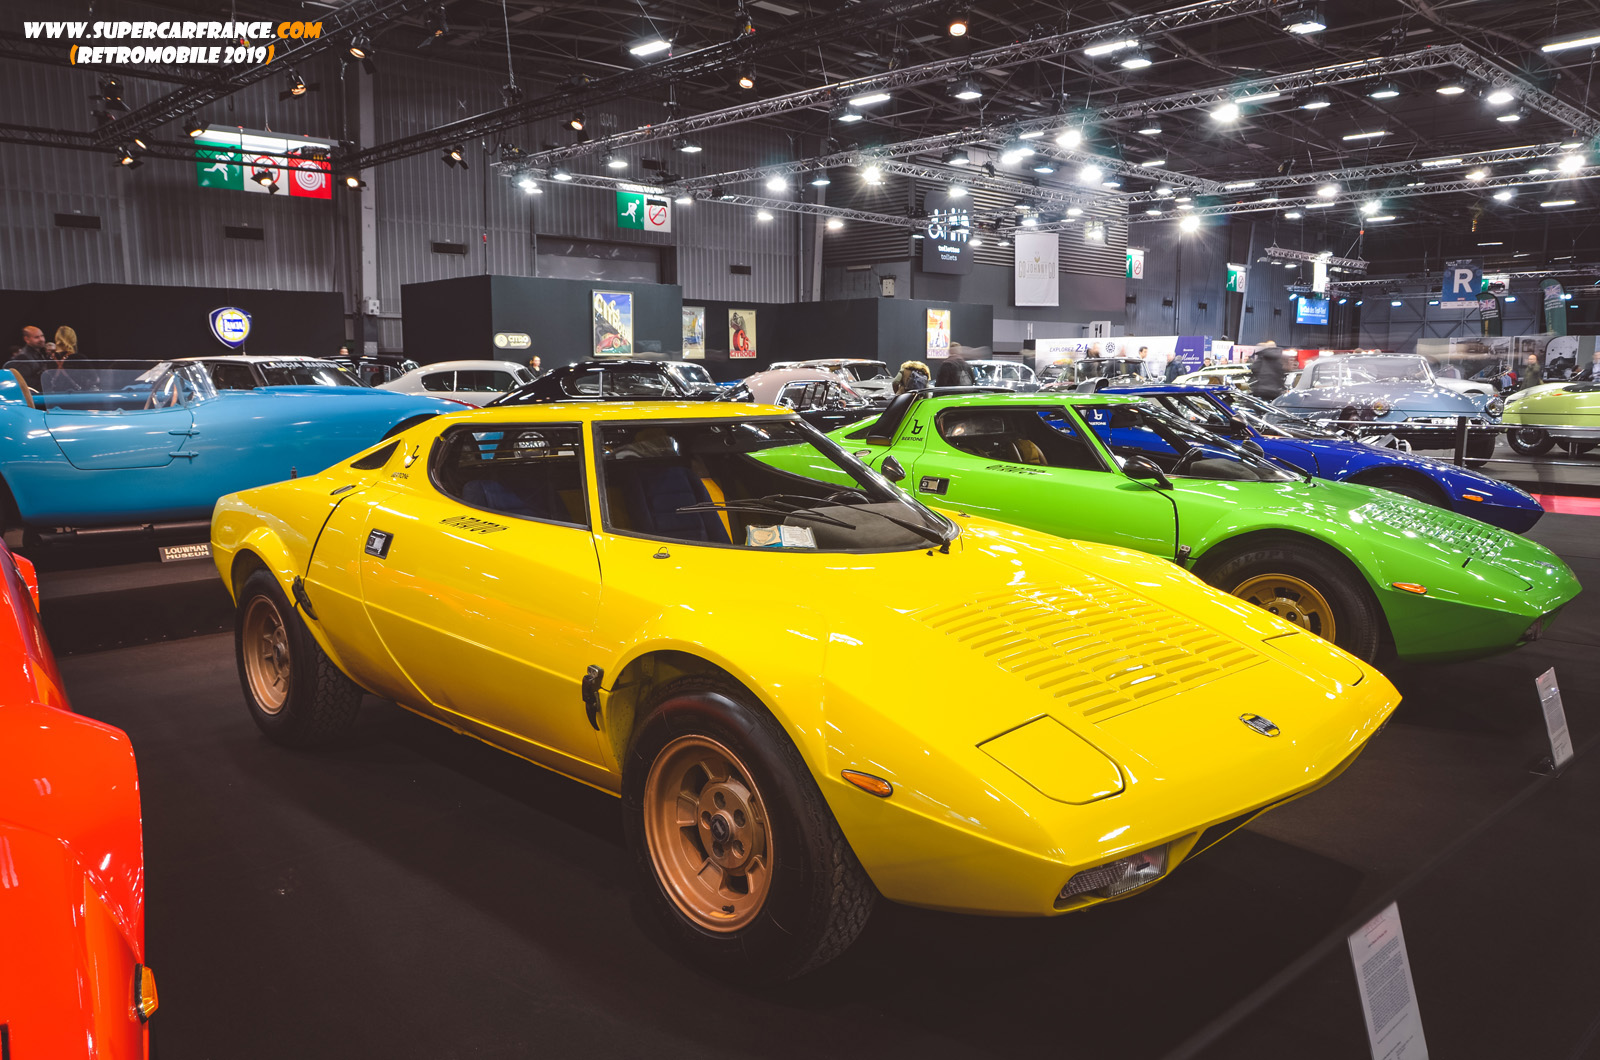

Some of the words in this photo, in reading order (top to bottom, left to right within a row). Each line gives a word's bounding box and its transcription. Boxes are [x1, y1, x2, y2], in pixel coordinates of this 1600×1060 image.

[1453, 268, 1474, 293] R
[164, 544, 208, 555] LOUWMAN
[166, 550, 210, 560] MUSEUM
